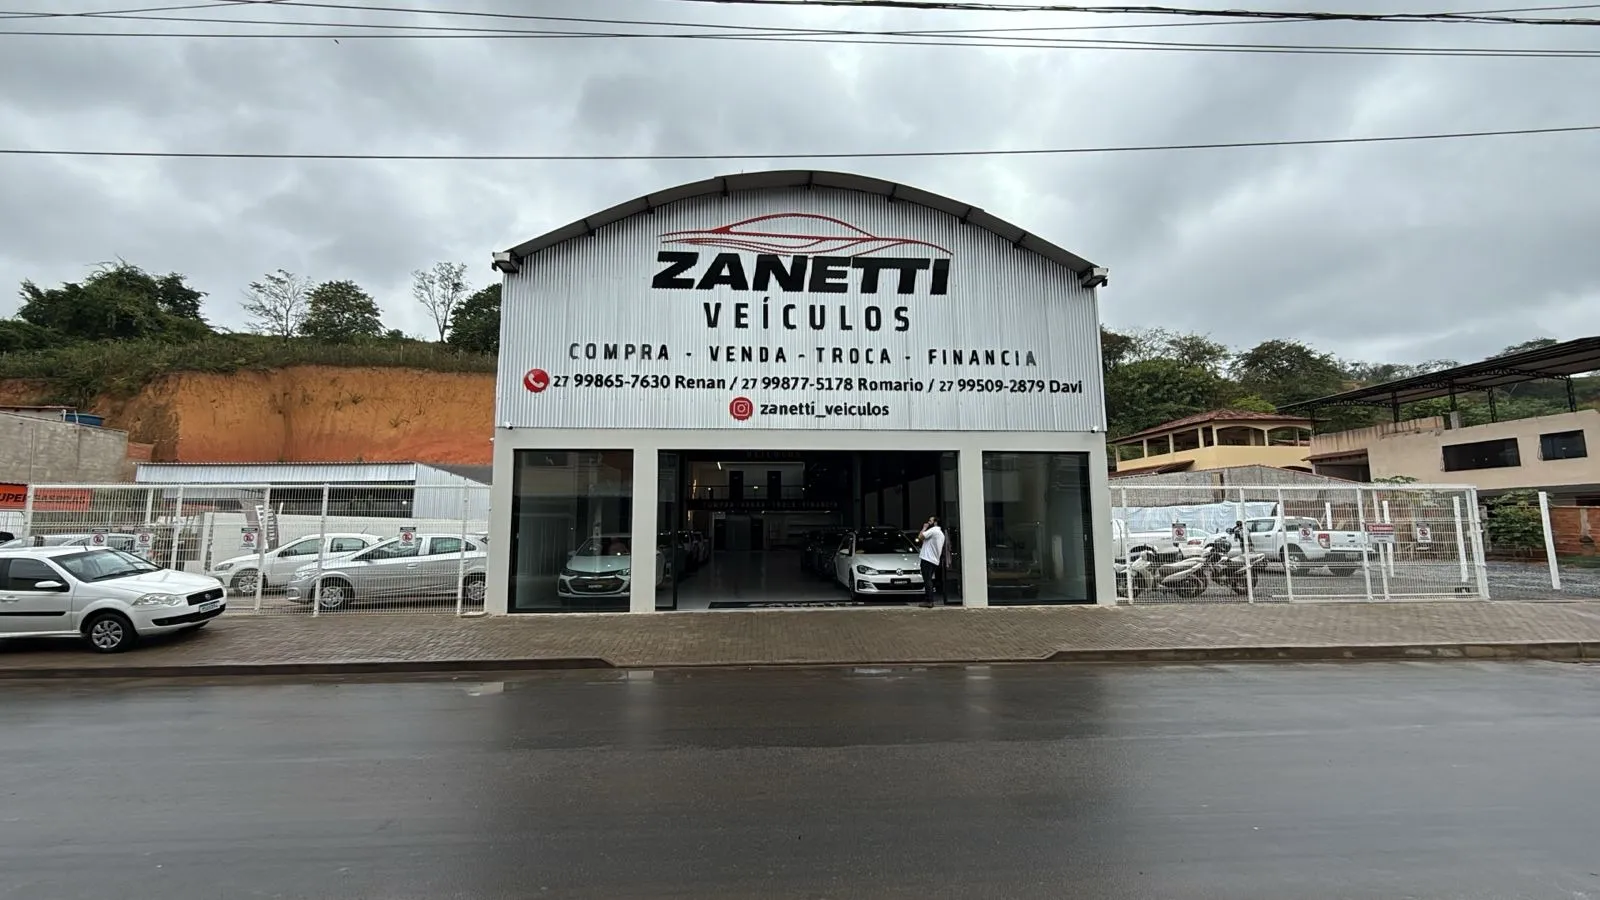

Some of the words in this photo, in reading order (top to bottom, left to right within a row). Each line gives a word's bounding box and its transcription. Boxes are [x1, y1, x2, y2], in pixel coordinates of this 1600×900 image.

[651, 250, 951, 296] ZANETTI
[703, 296, 910, 332] VEÍCULOS
[569, 342, 669, 361] COMPRA
[709, 345, 787, 363] VENDA
[815, 347, 891, 365] TROCA
[928, 348, 1037, 367] FINANCIA
[553, 375, 569, 388] 27
[573, 373, 671, 389] 99865-7630
[675, 375, 726, 390] Renan
[741, 378, 758, 390] 27
[761, 376, 854, 391] 99877-5178
[857, 377, 924, 392] Romario
[939, 380, 954, 393] 27
[957, 378, 1045, 393] 99509-2879
[1049, 379, 1083, 394] Davi
[760, 401, 890, 418] zanetti_veiculos
